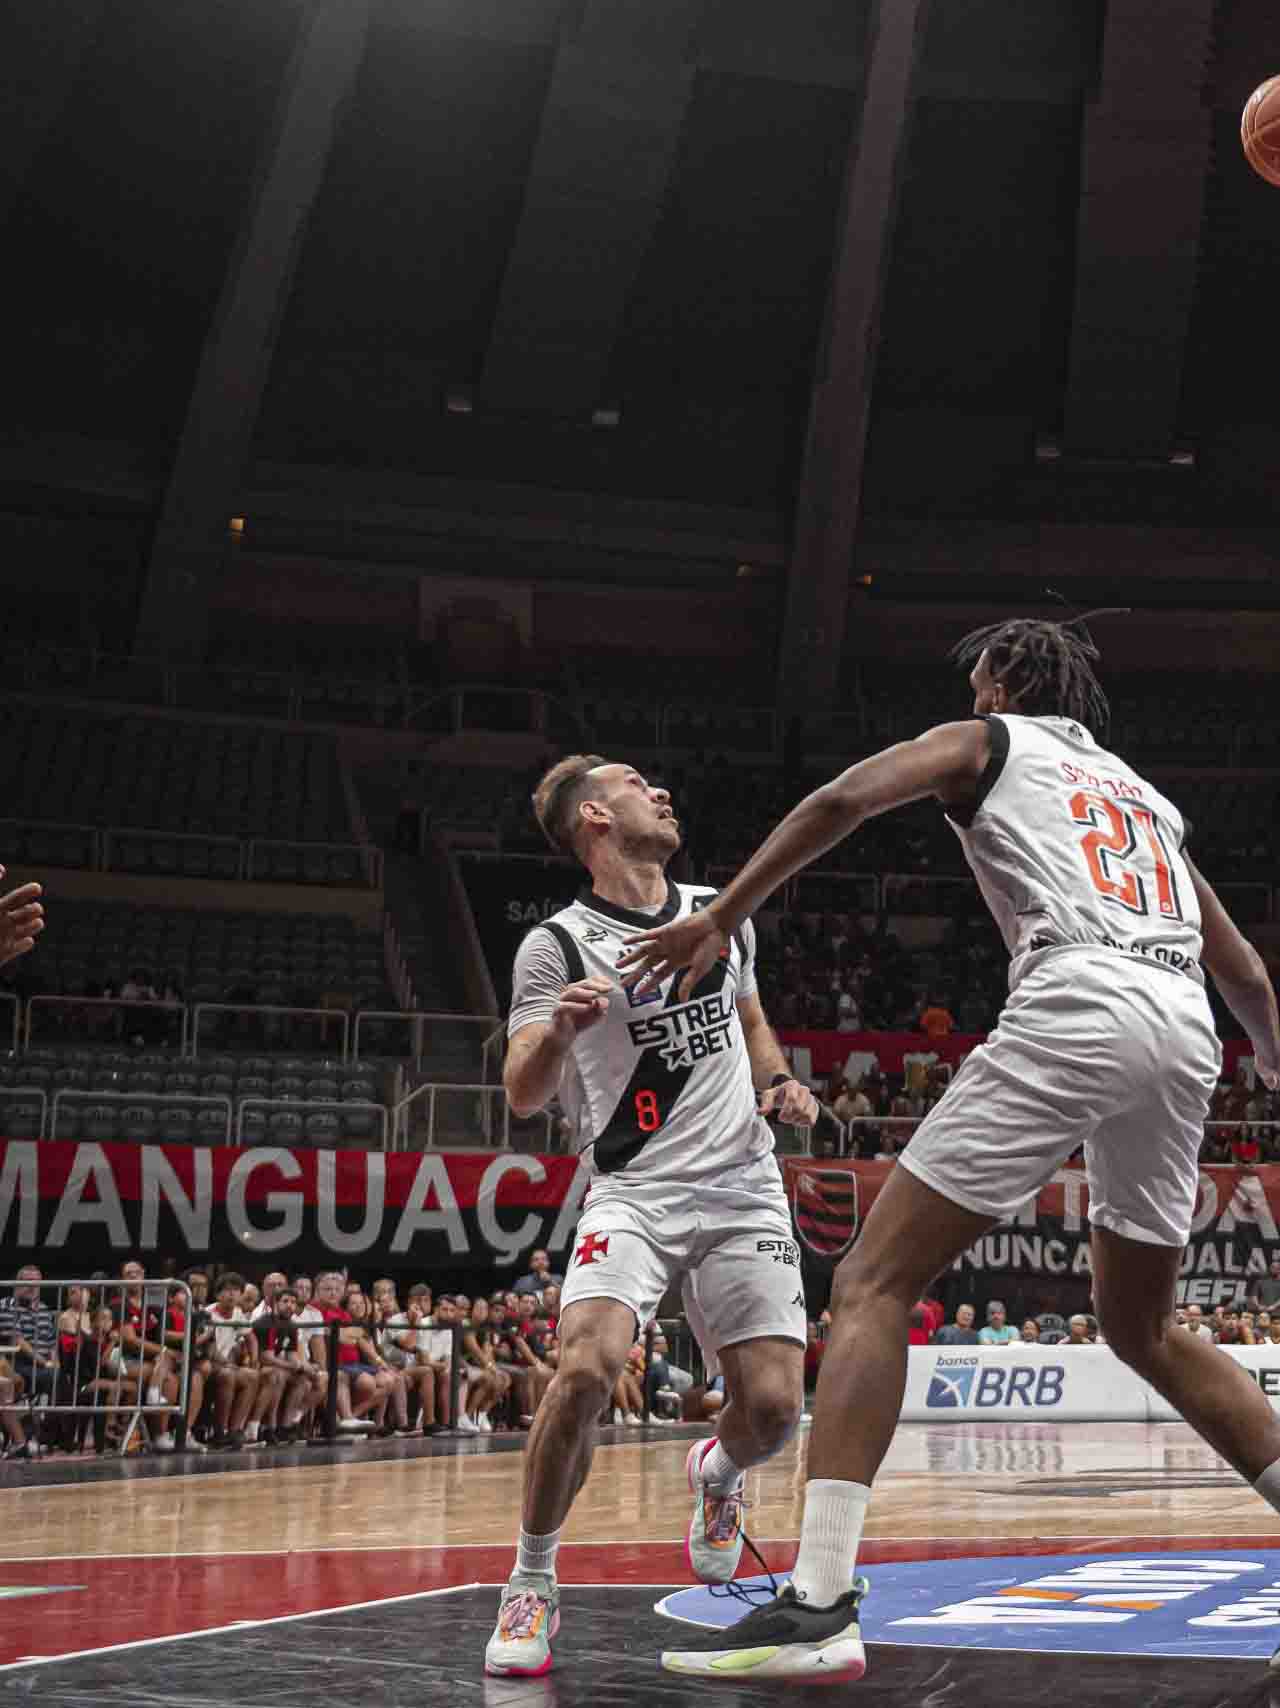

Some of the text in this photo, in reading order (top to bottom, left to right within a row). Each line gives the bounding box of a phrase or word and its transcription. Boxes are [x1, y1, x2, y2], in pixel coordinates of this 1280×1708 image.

[1070, 790, 1184, 922] 21
[688, 1022, 733, 1060] BET
[635, 1090, 660, 1131] 8
[936, 1355, 978, 1367] banco
[975, 1366, 1065, 1407] BRB
